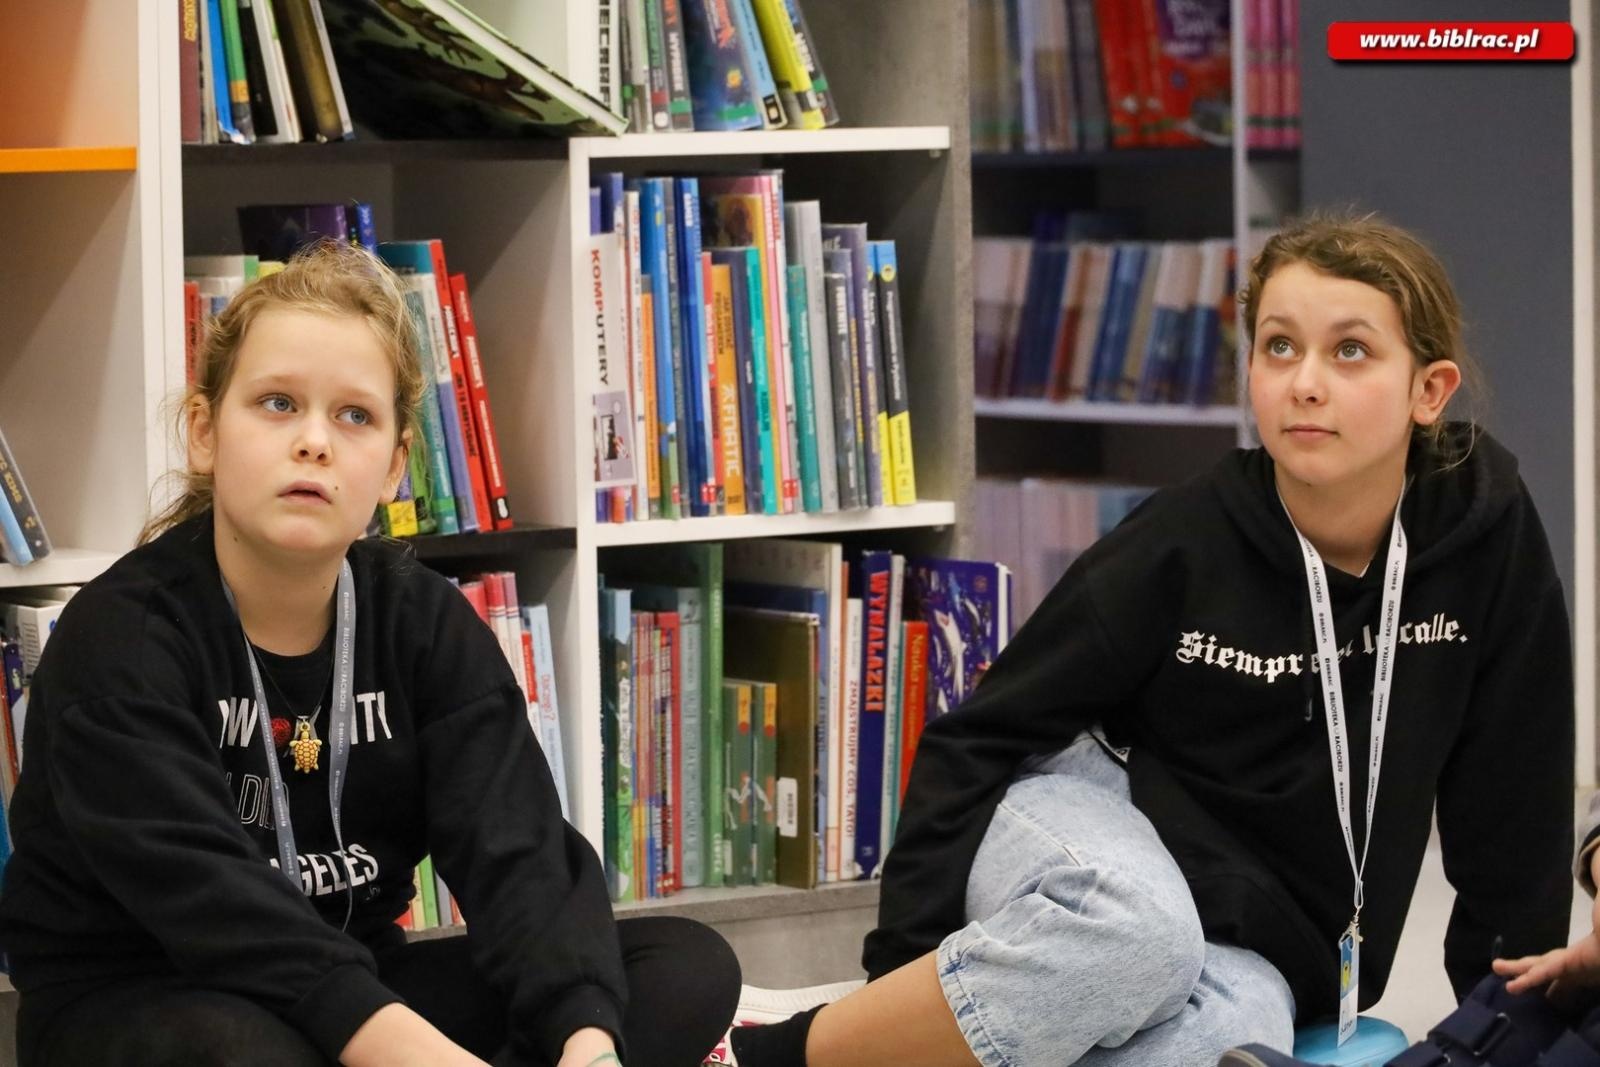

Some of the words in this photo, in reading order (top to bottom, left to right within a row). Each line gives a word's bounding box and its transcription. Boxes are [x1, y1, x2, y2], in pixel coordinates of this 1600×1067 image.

[599, 0, 611, 106] ECRAF
[591, 248, 610, 387] KOMPUTERY
[723, 402, 741, 477] FNATIC
[1312, 566, 1323, 603] RACIBORZU
[341, 627, 350, 664] BIBLIOTEKA
[865, 570, 889, 712] WYNALAZKI
[911, 632, 925, 683] Nauka
[1380, 645, 1390, 682] BIBLIOTEKA
[1385, 599, 1395, 637] RACIBORZU
[1399, 613, 1468, 645] calle.
[848, 680, 858, 766] ZMAJSTRUJMY
[1328, 691, 1340, 727] BIBLIOTEKA
[1334, 735, 1344, 773] RACIBORZU
[845, 802, 855, 838] TATO!
[270, 843, 379, 897] GELES
